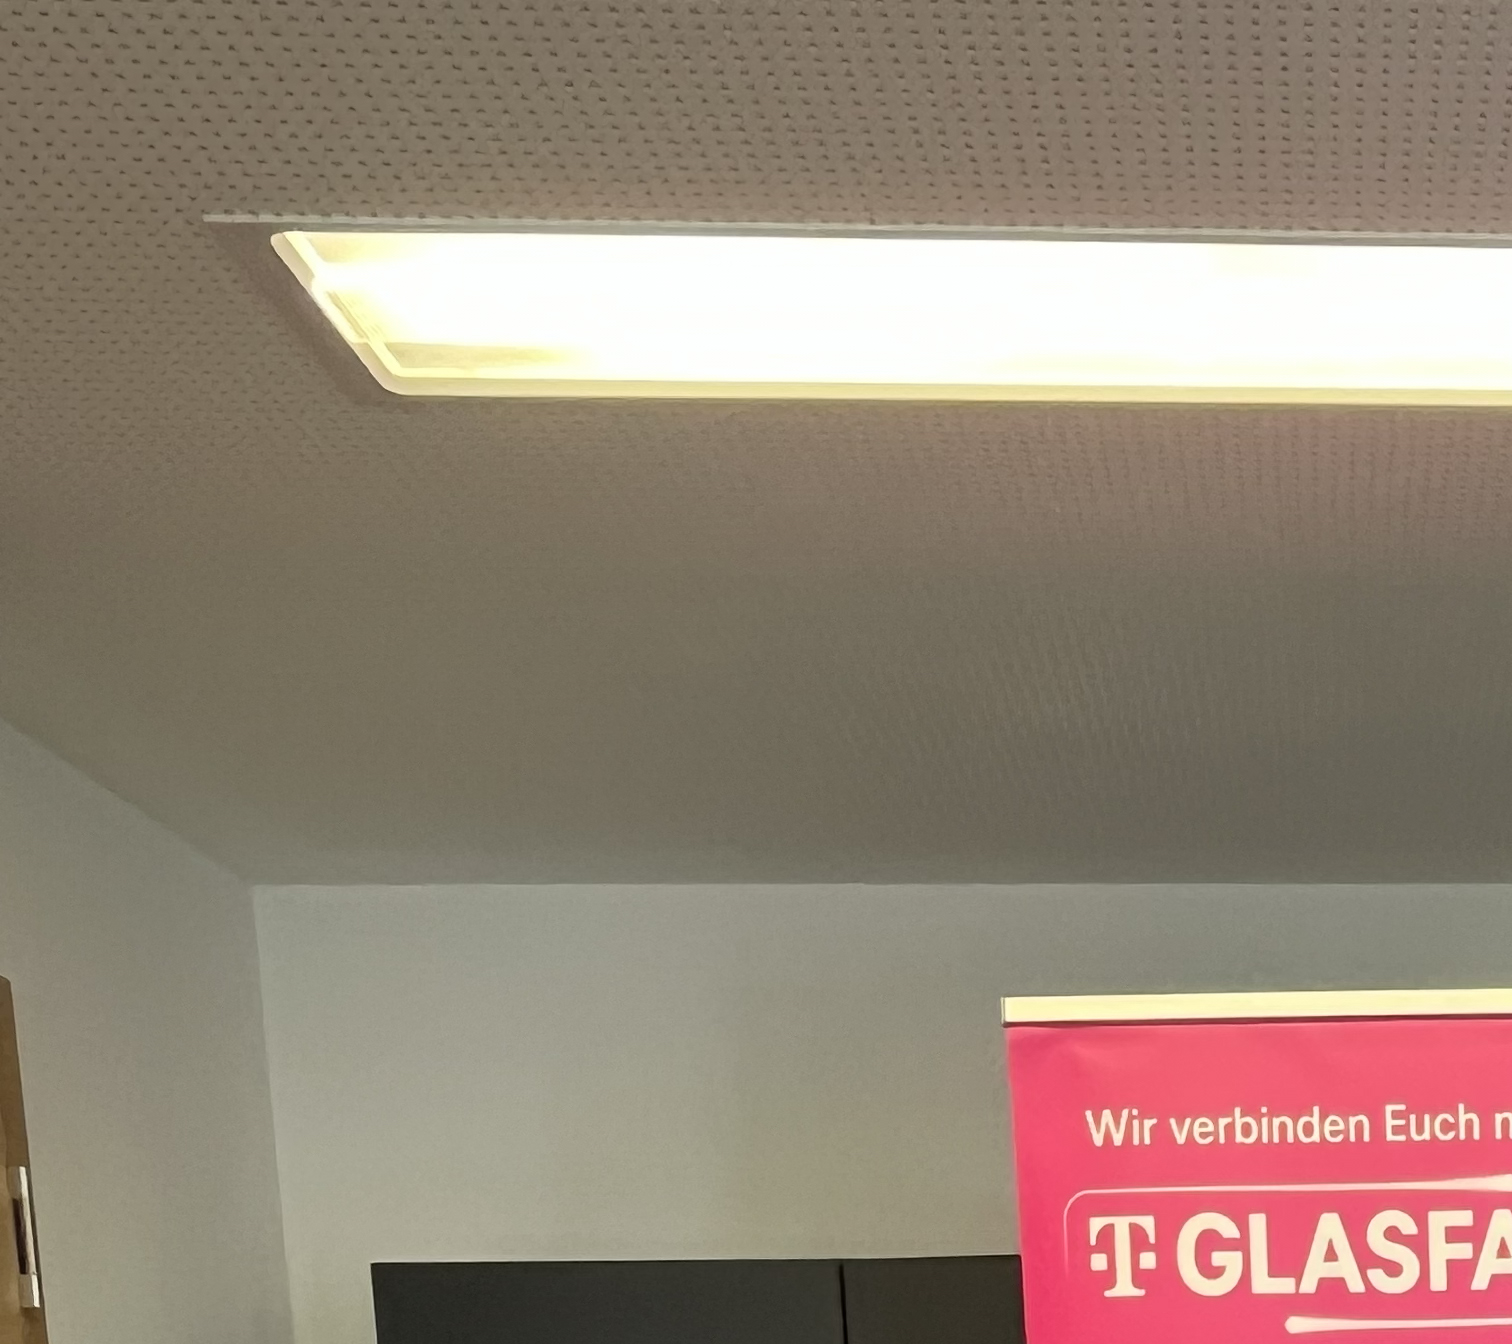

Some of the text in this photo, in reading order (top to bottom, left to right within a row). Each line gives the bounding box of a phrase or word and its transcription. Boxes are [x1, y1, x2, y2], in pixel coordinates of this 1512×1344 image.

[1085, 1108, 1158, 1147] Wir
[1169, 1105, 1370, 1145] verbinden
[1384, 1103, 1480, 1142] Euch
[1089, 1215, 1157, 1298] T
